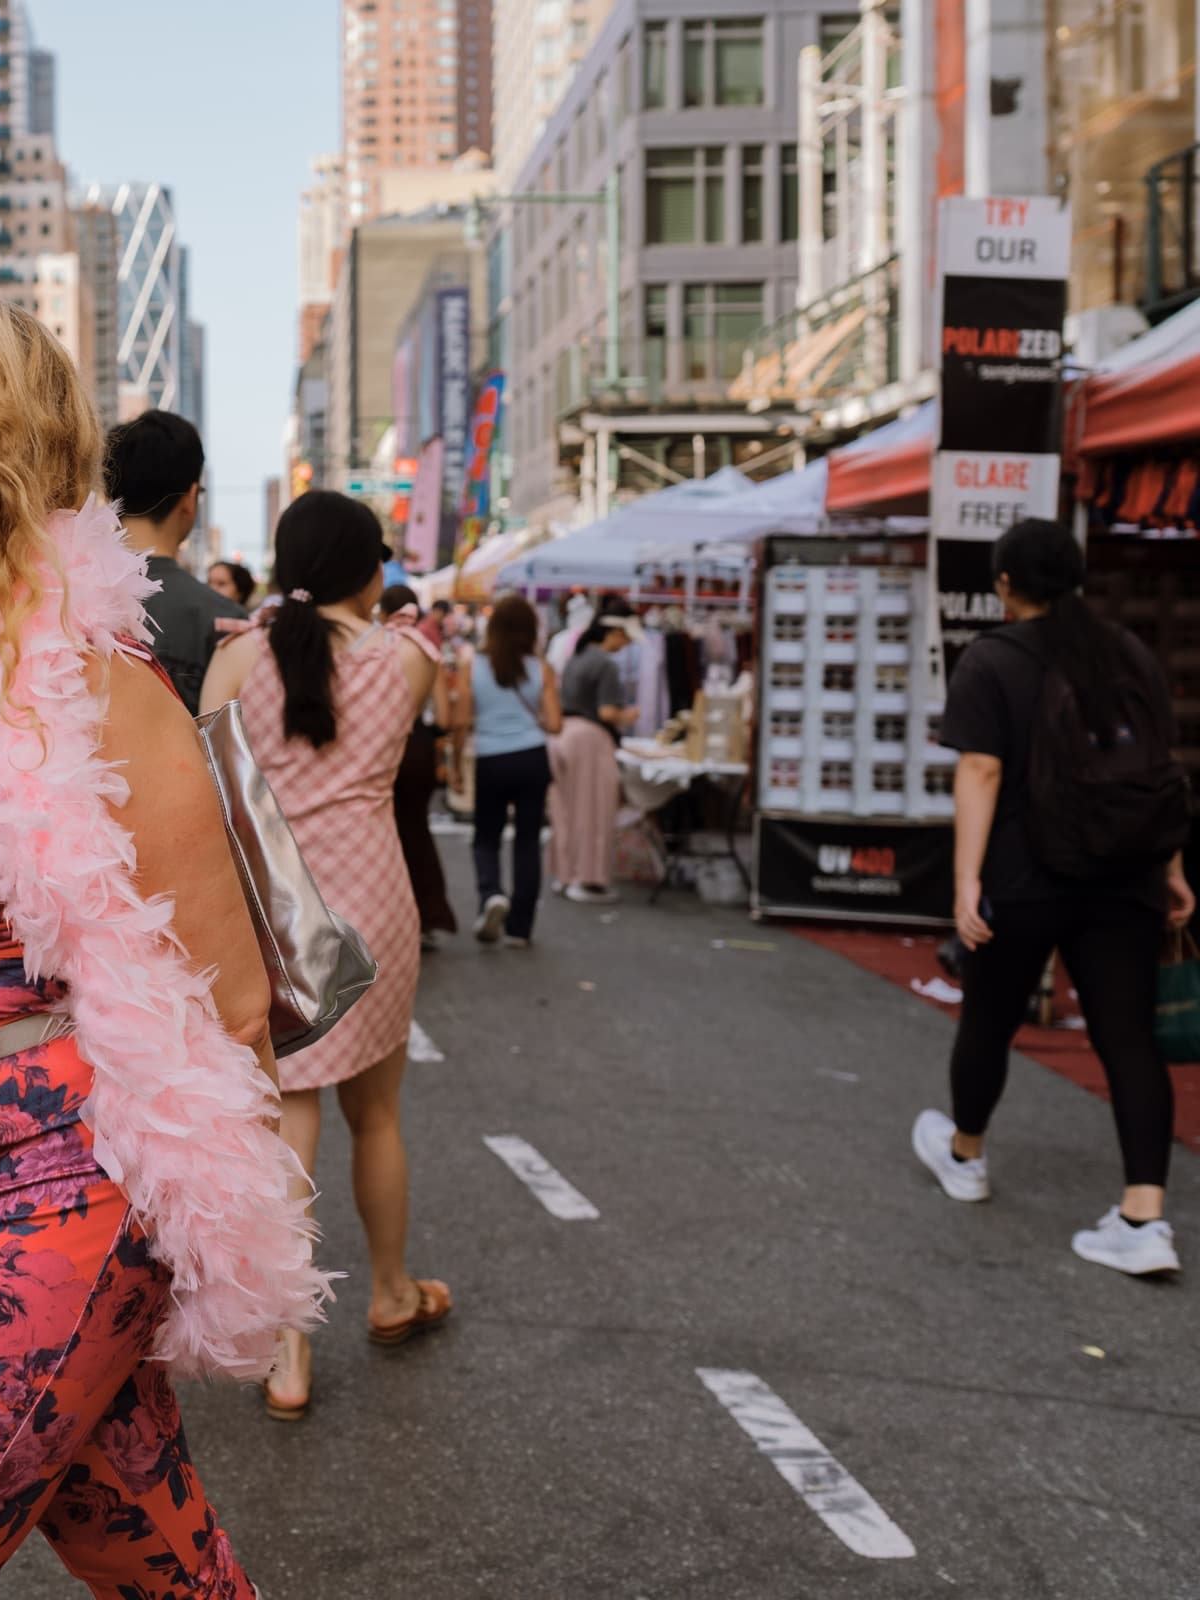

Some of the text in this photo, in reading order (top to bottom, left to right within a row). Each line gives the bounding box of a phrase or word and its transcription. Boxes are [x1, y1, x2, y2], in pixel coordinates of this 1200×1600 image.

[984, 198, 1029, 226] TRY
[976, 237, 1037, 263] OUR
[942, 326, 1060, 359] POLARIZED
[955, 459, 1030, 491] GLARE
[959, 501, 1027, 527] FREE
[818, 845, 896, 876] UV400
